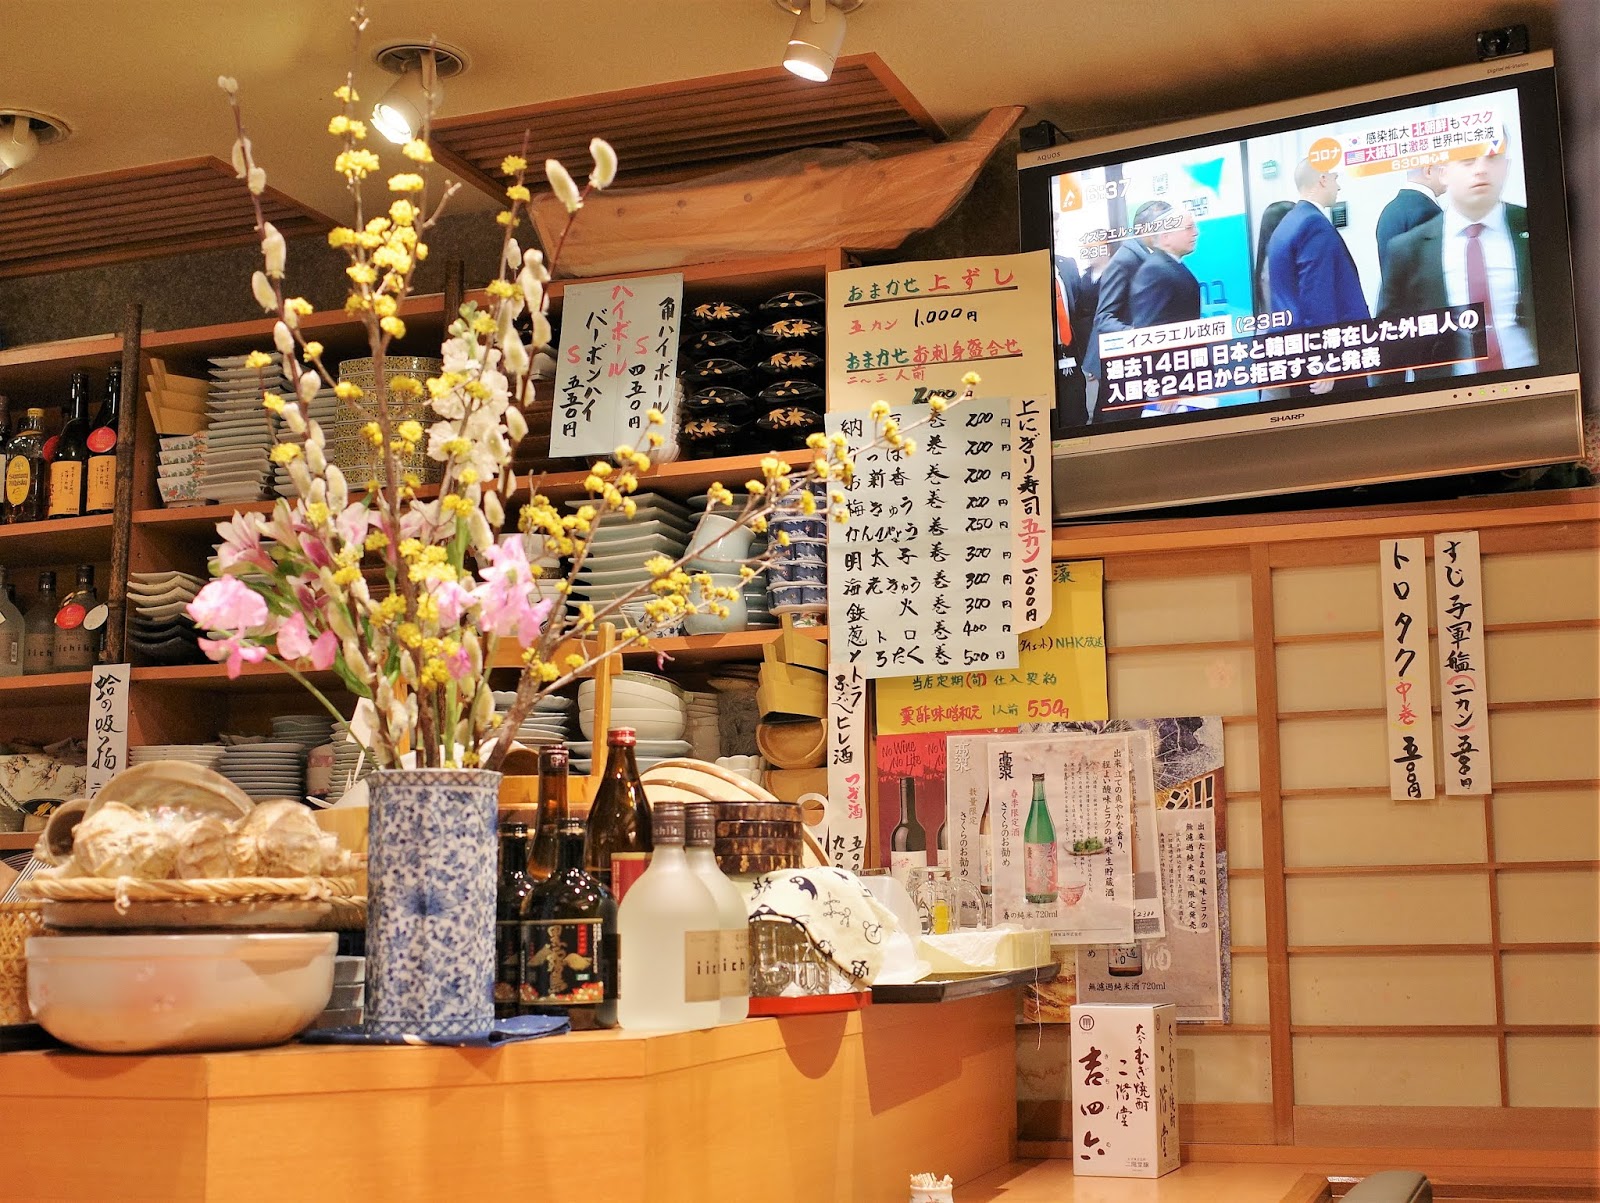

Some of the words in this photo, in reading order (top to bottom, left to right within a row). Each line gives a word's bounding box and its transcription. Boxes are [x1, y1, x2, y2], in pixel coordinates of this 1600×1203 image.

[1366, 124, 1410, 145] 感染拡大
[1411, 110, 1494, 139] 北朝鮮もマスク
[1365, 138, 1430, 162] 大統領は激怒
[1432, 126, 1496, 149] 世界中に余波
[1036, 151, 1061, 161] AQUOS
[1310, 147, 1342, 164] コロナ
[607, 285, 634, 378] ハイボール
[1126, 321, 1227, 348] イスラエル政府
[1105, 347, 1210, 381] 過去14日間
[1211, 309, 1480, 366] 日本と韓国に滞在した外国人の
[581, 308, 609, 423] バーボンハイ
[1107, 346, 1381, 404] 入国を24日から拒否すると発表
[1269, 413, 1305, 423] SHARP
[964, 546, 1012, 563] 300円
[965, 572, 1012, 590] 300円
[965, 597, 1012, 615] 300円
[881, 744, 893, 758] No
[893, 739, 917, 755] Wine
[1035, 910, 1058, 919] 720ml
[1087, 982, 1140, 992] 無濾過純米酒
[1141, 981, 1166, 990] 720ml
[1115, 1058, 1133, 1127] 二階堂
